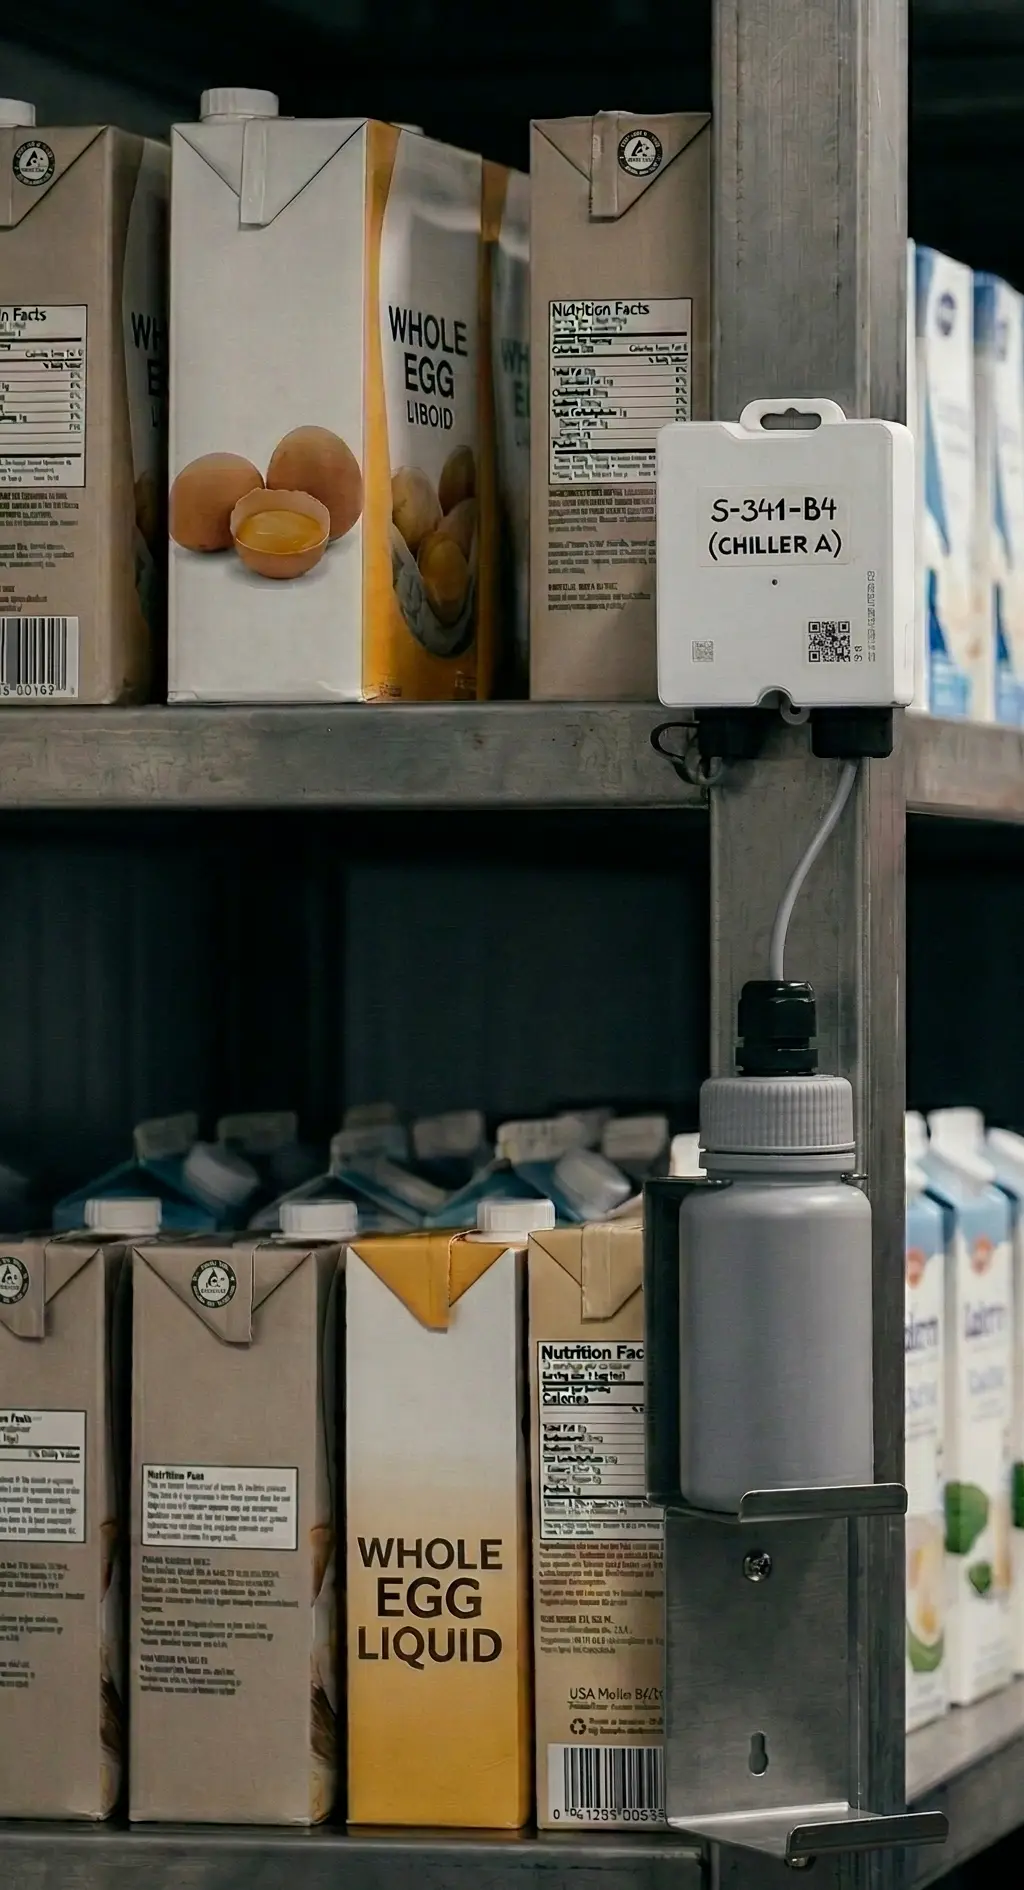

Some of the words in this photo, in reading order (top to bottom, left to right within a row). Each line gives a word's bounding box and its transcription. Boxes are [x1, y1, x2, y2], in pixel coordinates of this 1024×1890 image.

[615, 302, 650, 315] Facts
[388, 305, 468, 357] WHOLE
[404, 352, 454, 399] EGG
[711, 497, 837, 522] S-341-B4
[708, 531, 808, 561] (CHILLER
[814, 529, 842, 558] A)
[541, 1345, 611, 1359] Nutrition
[357, 1537, 503, 1570] WHOLE
[377, 1577, 482, 1619] EGG
[358, 1626, 503, 1670] LIQUID
[569, 1687, 595, 1700] USA
